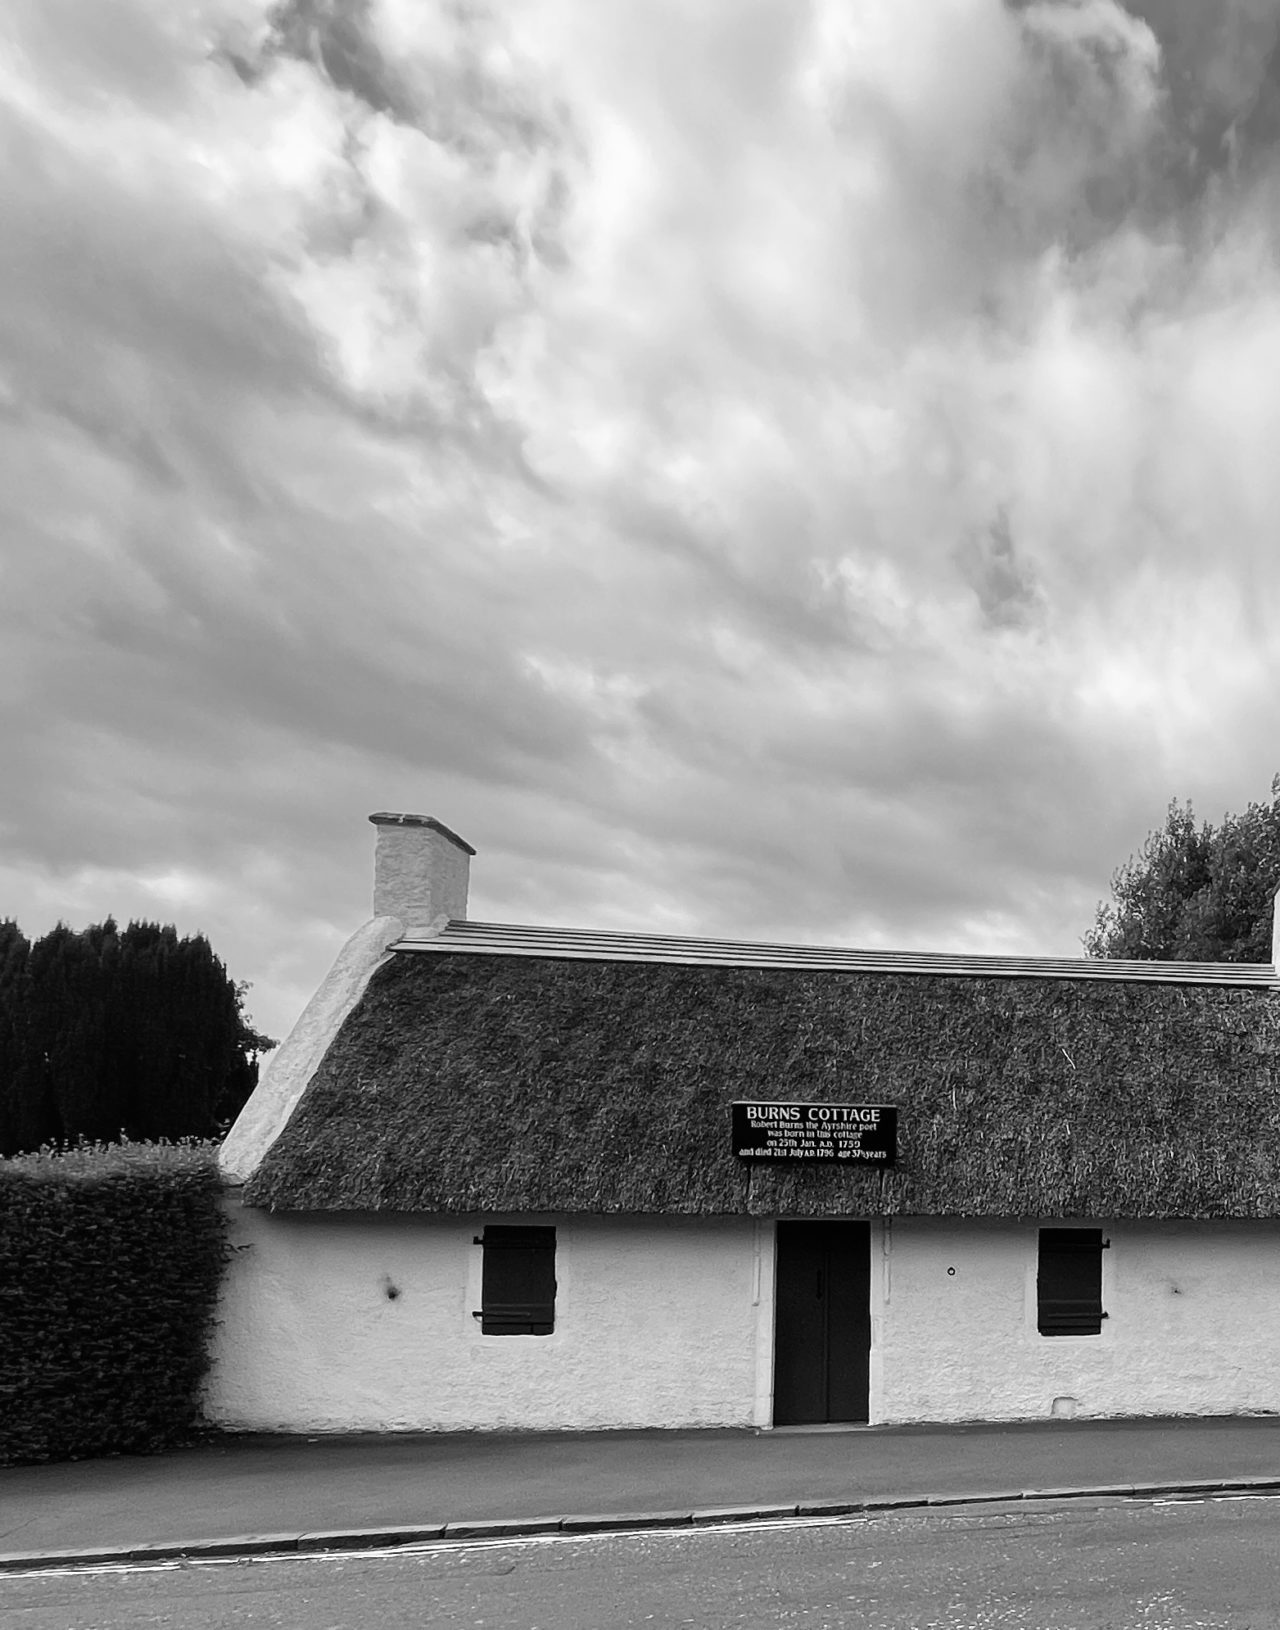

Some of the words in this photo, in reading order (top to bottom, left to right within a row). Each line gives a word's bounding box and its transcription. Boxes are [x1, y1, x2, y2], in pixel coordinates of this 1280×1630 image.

[747, 1106, 801, 1120] BURNS
[808, 1107, 881, 1122] COTTAGE
[751, 1120, 777, 1128] Robert
[779, 1121, 804, 1129] Burns
[806, 1121, 818, 1130] the
[821, 1121, 857, 1131] Ayrshire
[859, 1123, 877, 1131] poet
[784, 1129, 805, 1137] born
[806, 1130, 815, 1138] in
[817, 1130, 831, 1138] this
[833, 1131, 863, 1140] cottage
[766, 1139, 777, 1147] on
[778, 1138, 798, 1147] 25th
[839, 1140, 861, 1148] 1759
[739, 1148, 754, 1156] and
[755, 1147, 772, 1156] died
[816, 1149, 834, 1157] 1796
